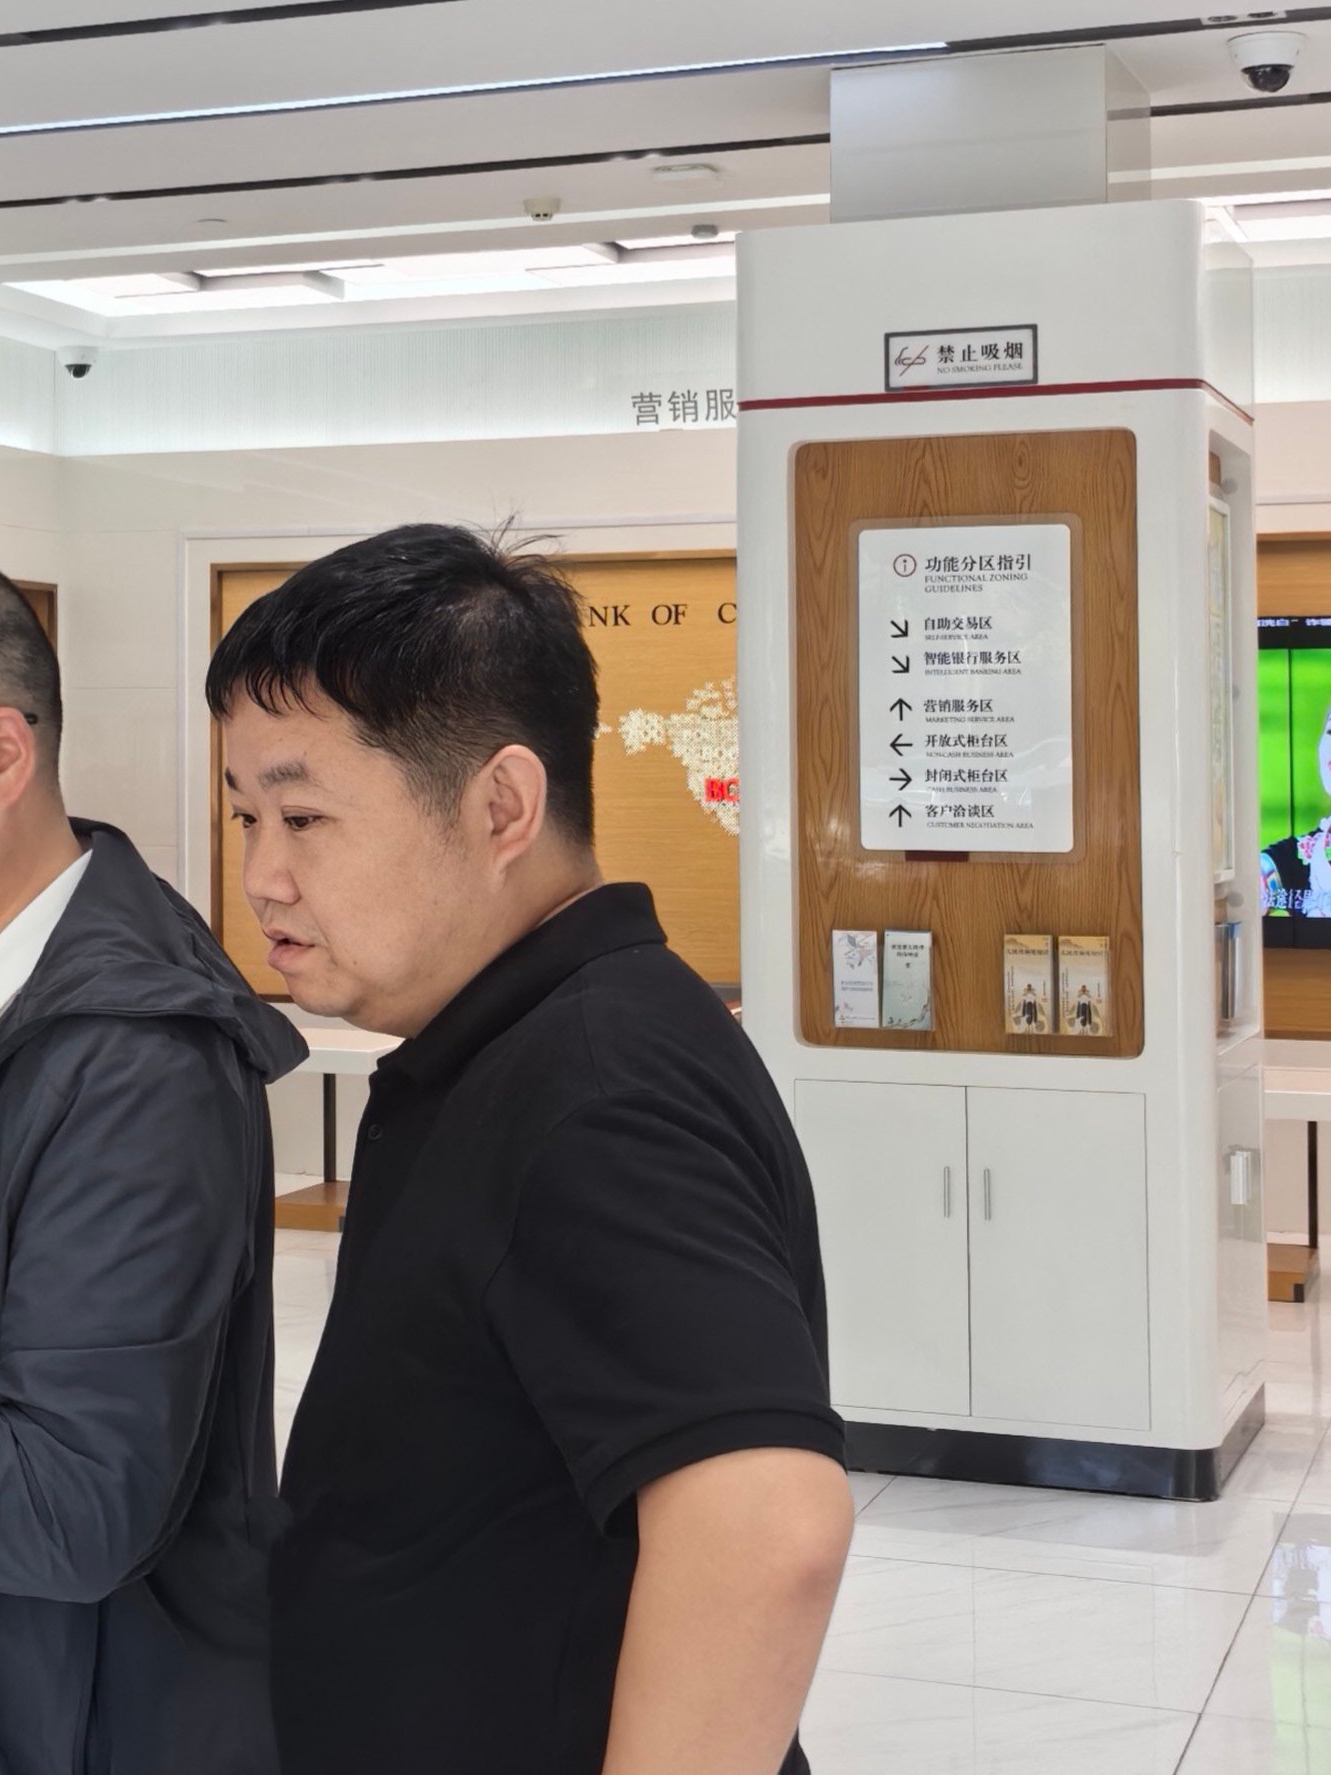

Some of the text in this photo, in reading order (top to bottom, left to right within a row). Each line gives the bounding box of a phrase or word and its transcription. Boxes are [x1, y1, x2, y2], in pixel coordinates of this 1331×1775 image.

[937, 341, 1023, 363] 禁止吸烟
[952, 365, 991, 374] SMOKING
[994, 363, 1023, 371] PLEASE
[631, 389, 736, 425] 营销服
[925, 554, 1031, 572] 功能分区指引
[925, 573, 1028, 583] FUNCTIONAL ZONING
[925, 584, 983, 593] GUIDELINES
[651, 604, 688, 626] OF
[924, 616, 993, 631] 自助交易区
[923, 650, 1021, 665] 智能银行服务区
[923, 699, 993, 713] 营销服务区
[925, 734, 1008, 748] 开放式柜台区
[925, 769, 1008, 783] 封闭式柜台区
[925, 804, 995, 818] 客户洽谈区
